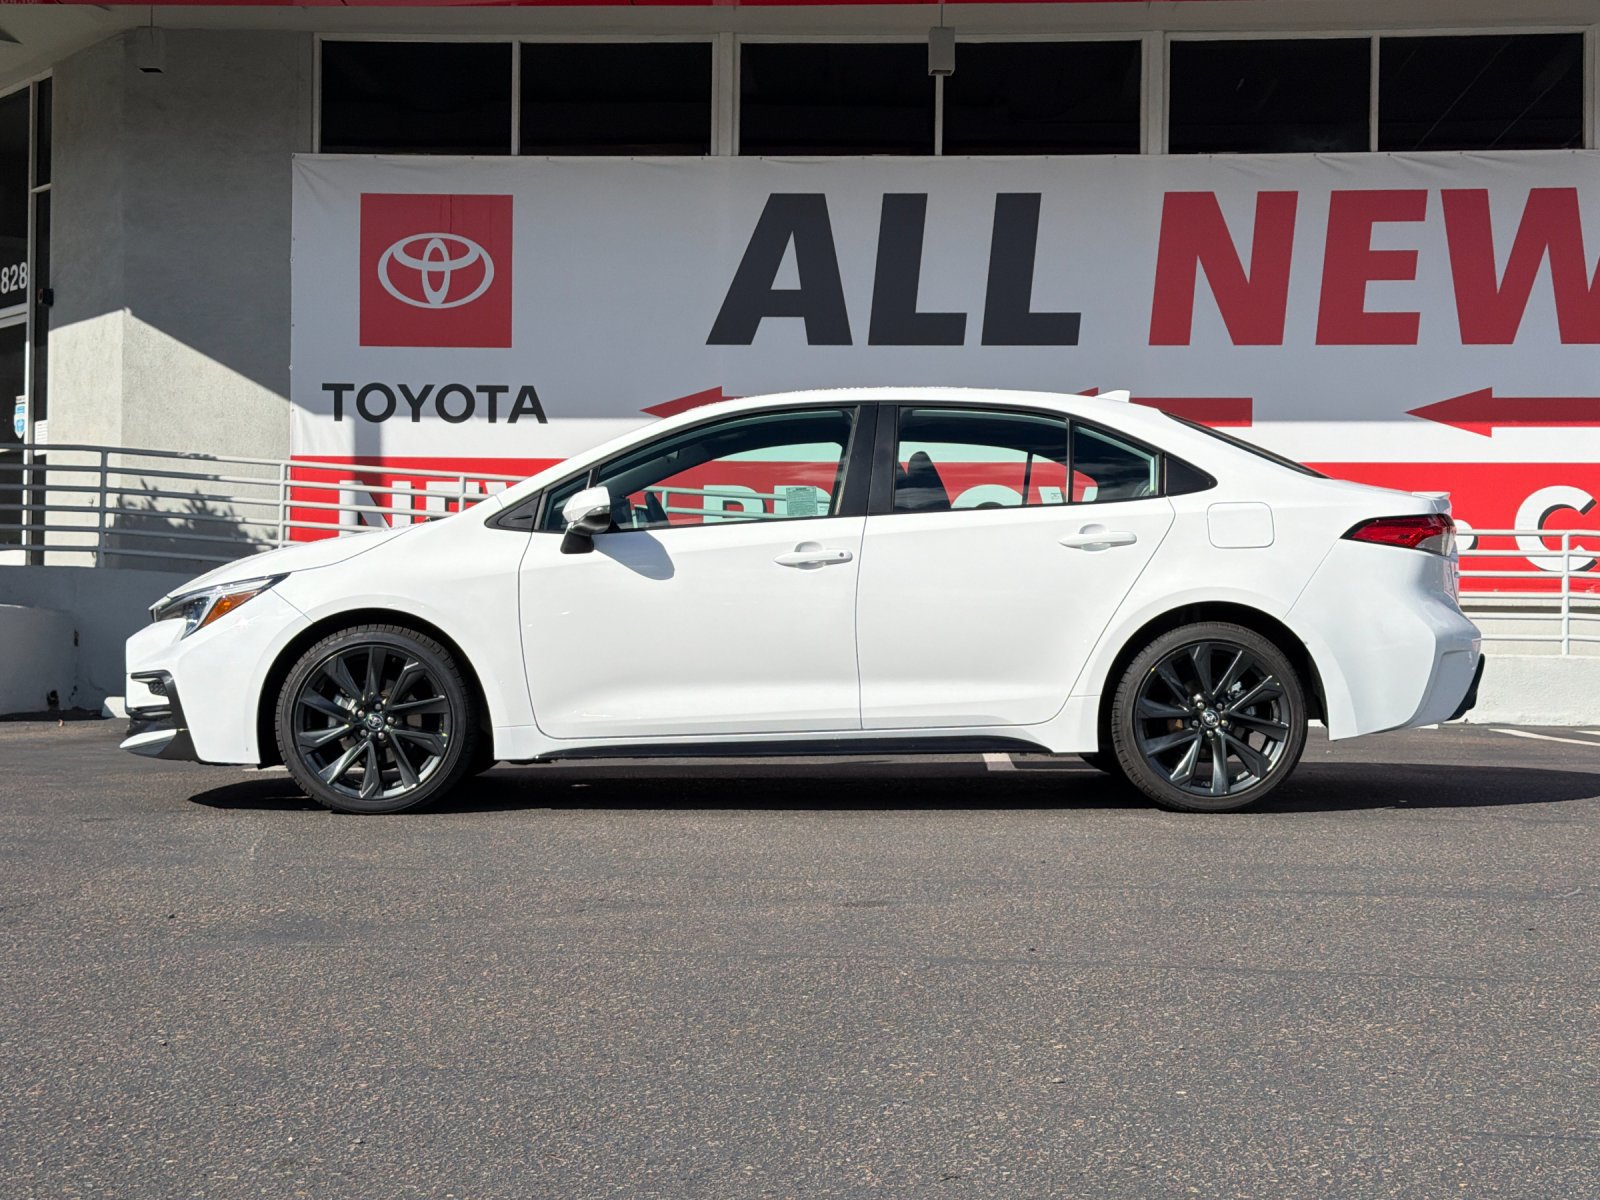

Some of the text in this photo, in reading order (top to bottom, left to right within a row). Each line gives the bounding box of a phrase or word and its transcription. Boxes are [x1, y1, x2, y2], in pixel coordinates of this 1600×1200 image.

[1, 262, 27, 294] 828
[706, 187, 1600, 346] ALL NEW
[322, 382, 548, 424] TOYOTA
